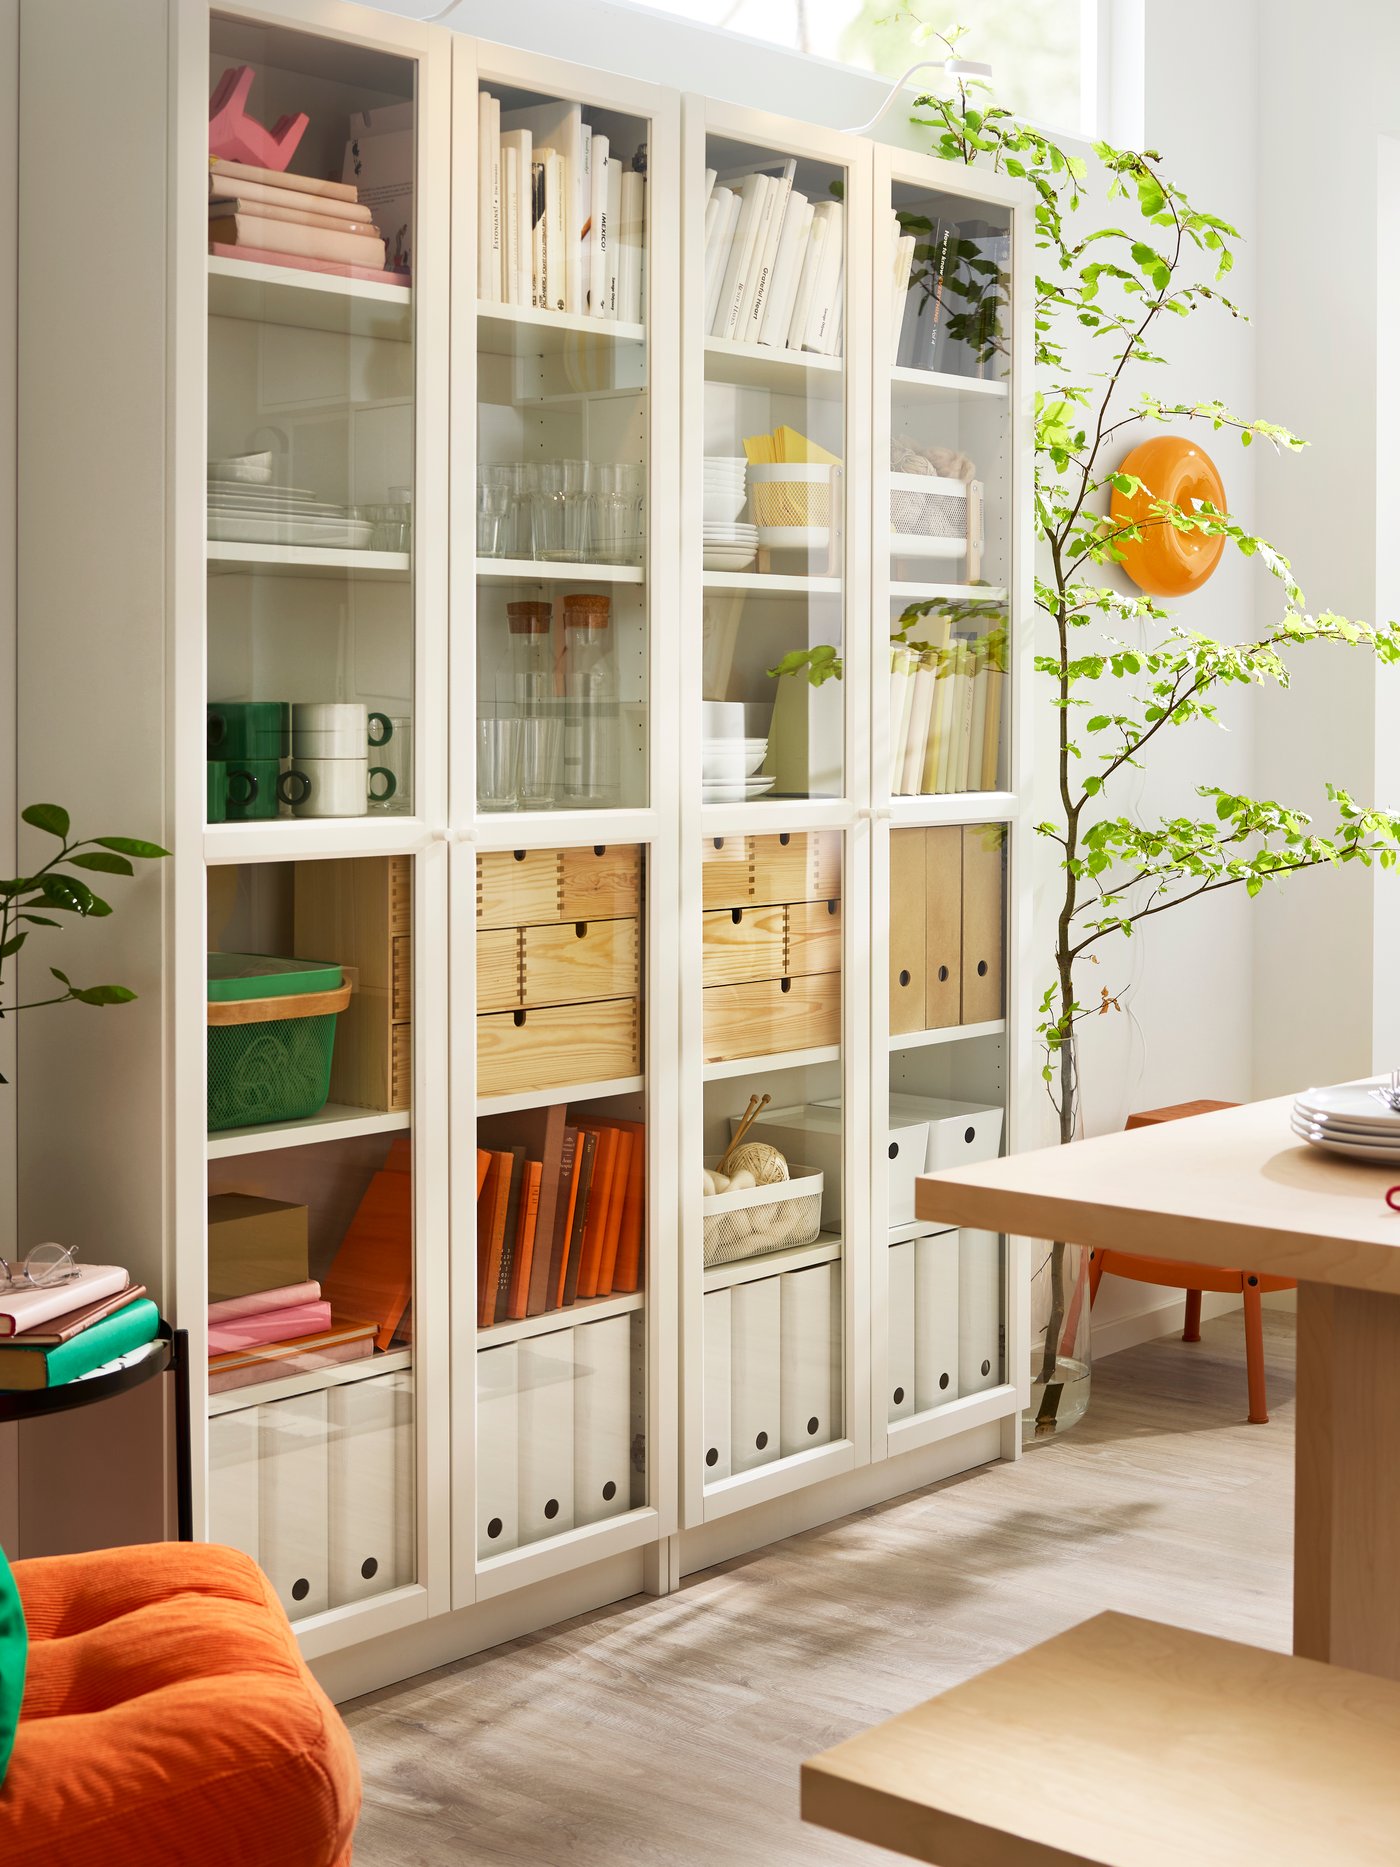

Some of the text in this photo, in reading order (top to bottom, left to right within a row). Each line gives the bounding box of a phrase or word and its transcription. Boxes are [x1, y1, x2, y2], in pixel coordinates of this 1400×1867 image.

[939, 255, 947, 276] know
[941, 247, 948, 256] to
[752, 267, 769, 320] Grateful Heart
[933, 275, 944, 324] EVERYTHING
